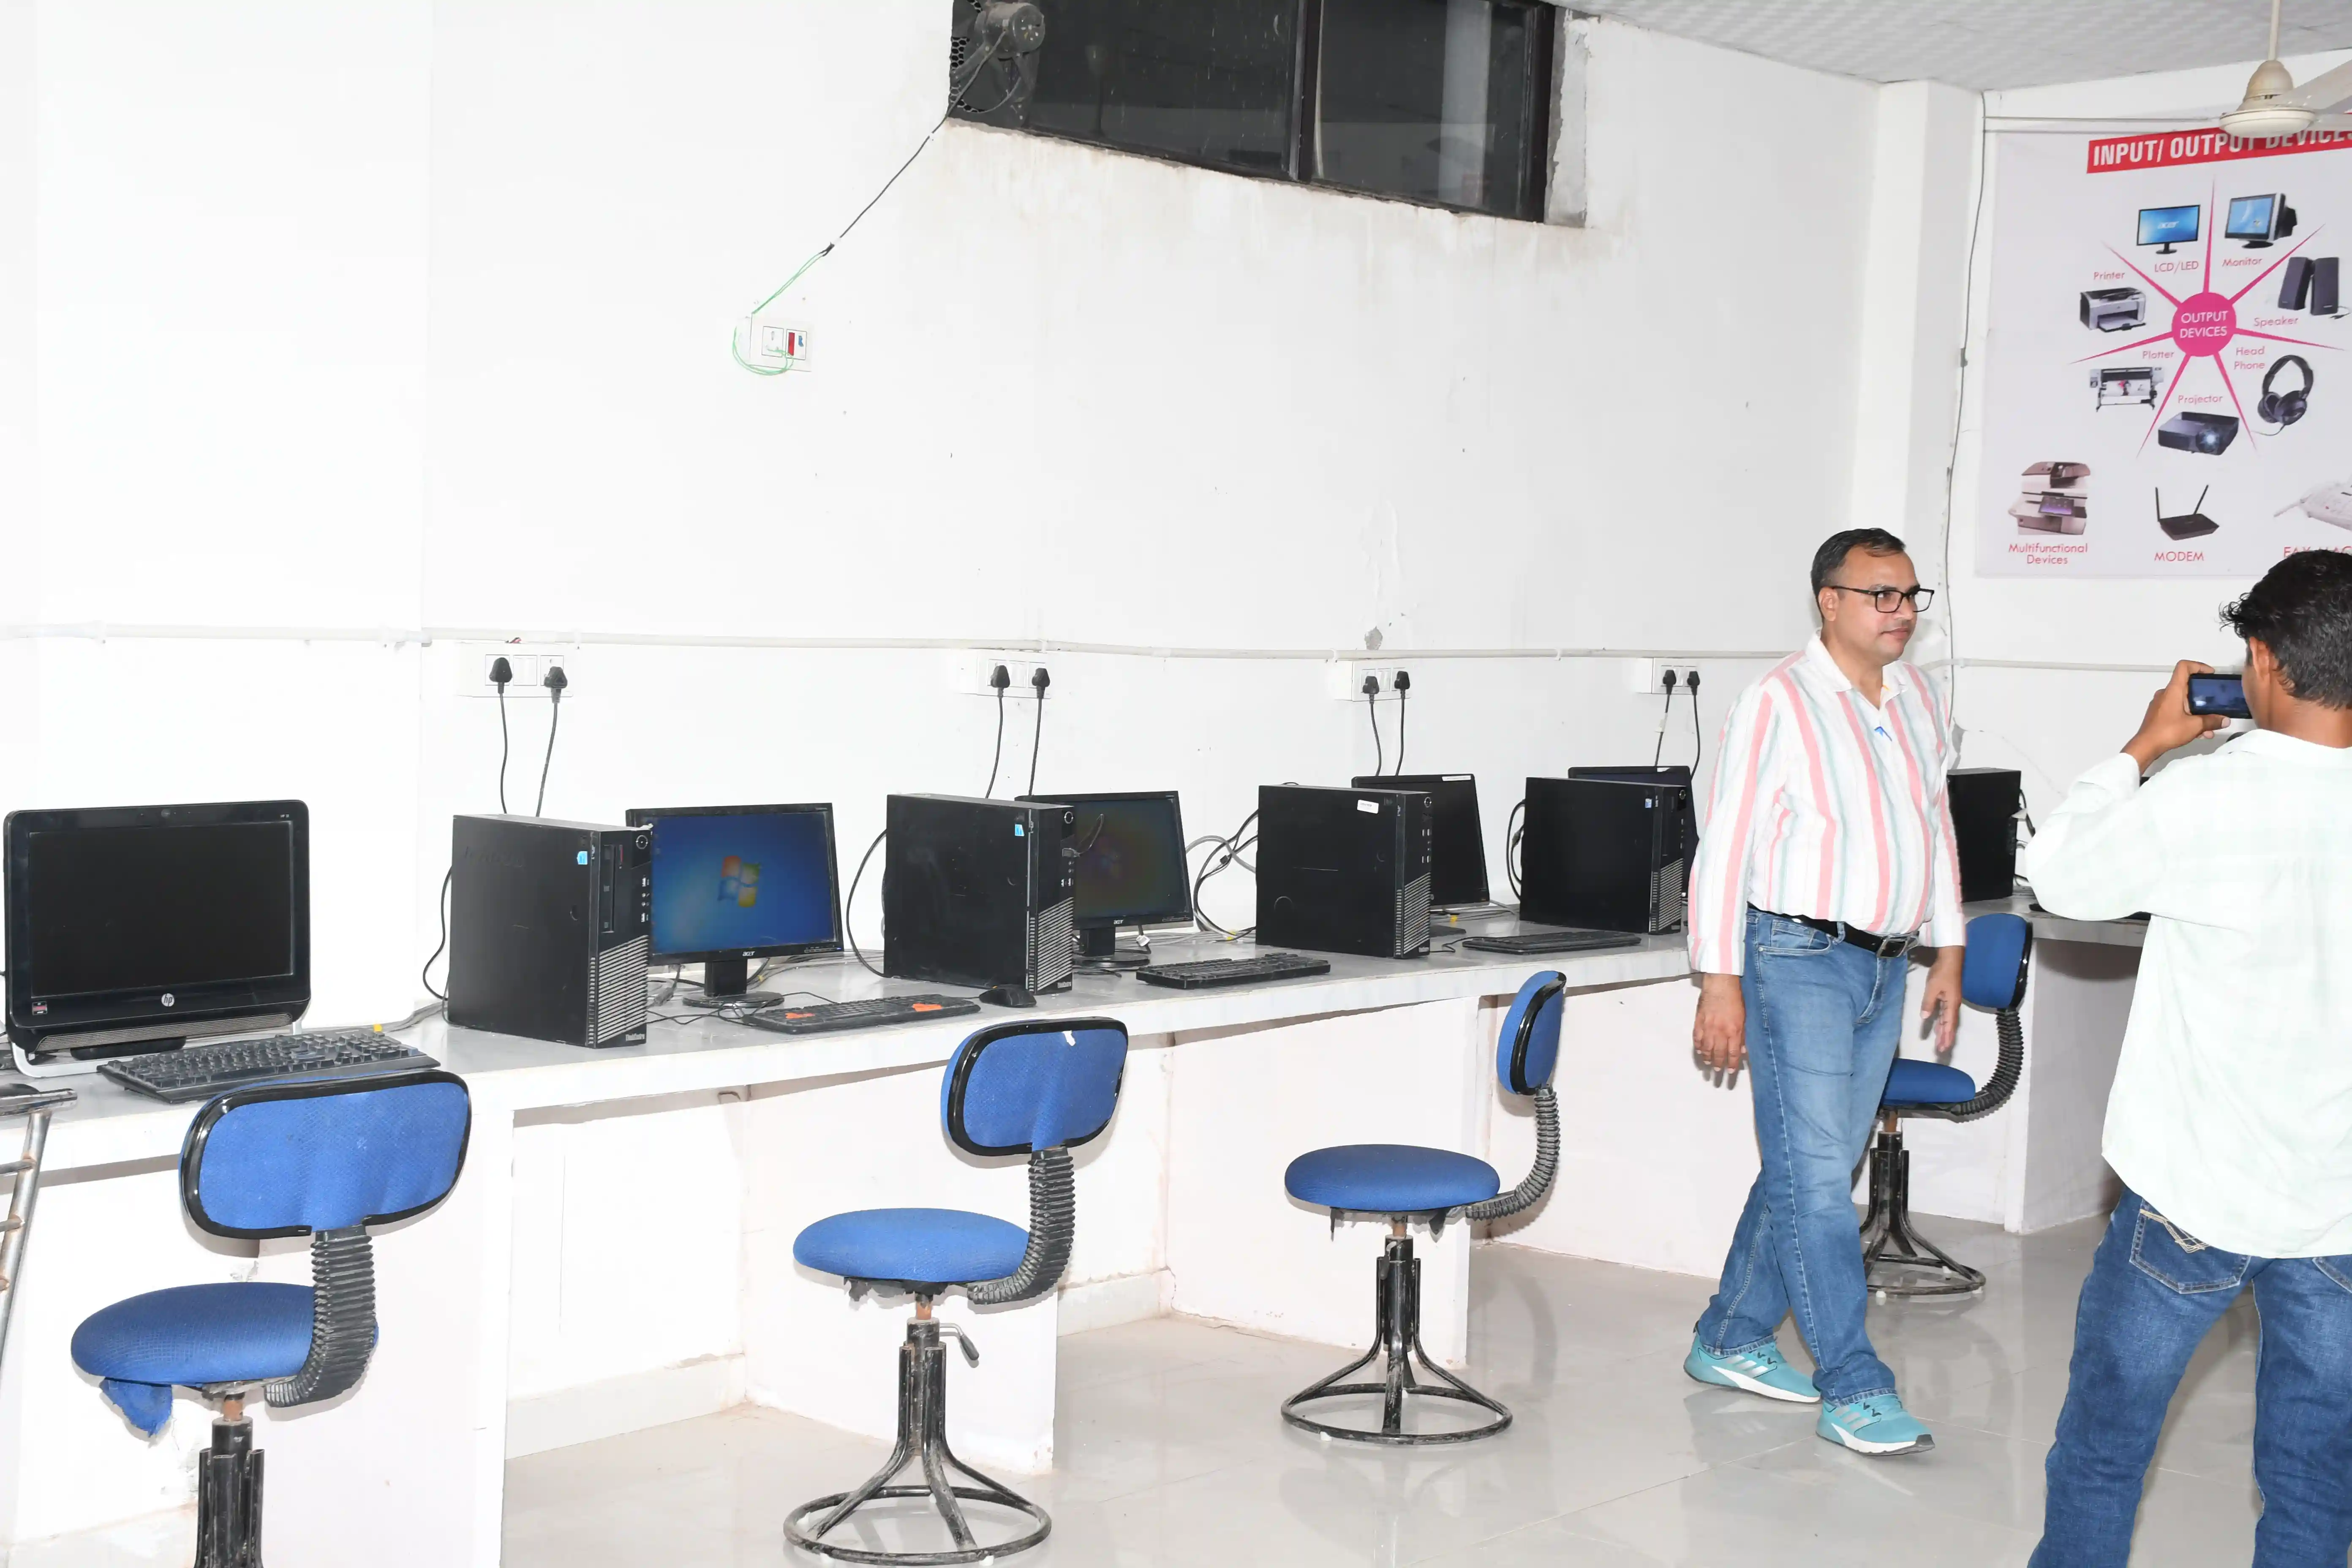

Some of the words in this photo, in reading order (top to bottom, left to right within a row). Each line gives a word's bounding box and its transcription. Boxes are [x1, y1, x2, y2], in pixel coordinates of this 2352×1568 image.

[2093, 139, 2164, 166] INPUT/
[2265, 131, 2352, 149] DEVICE
[2154, 261, 2199, 274] LCD/LED
[2222, 257, 2263, 267] Monitor
[2093, 272, 2125, 280] Printer
[2181, 310, 2228, 324] OUTPUT
[2254, 315, 2299, 328] Speaker
[2180, 326, 2228, 338] DEVICES
[2142, 351, 2175, 359] Plotter
[2236, 346, 2265, 356] Head
[2233, 361, 2265, 370] Phone
[2178, 394, 2224, 406] Projector
[2008, 542, 2088, 553] Multifunctional
[2027, 554, 2068, 564] Devices
[2154, 550, 2204, 561] MODEM
